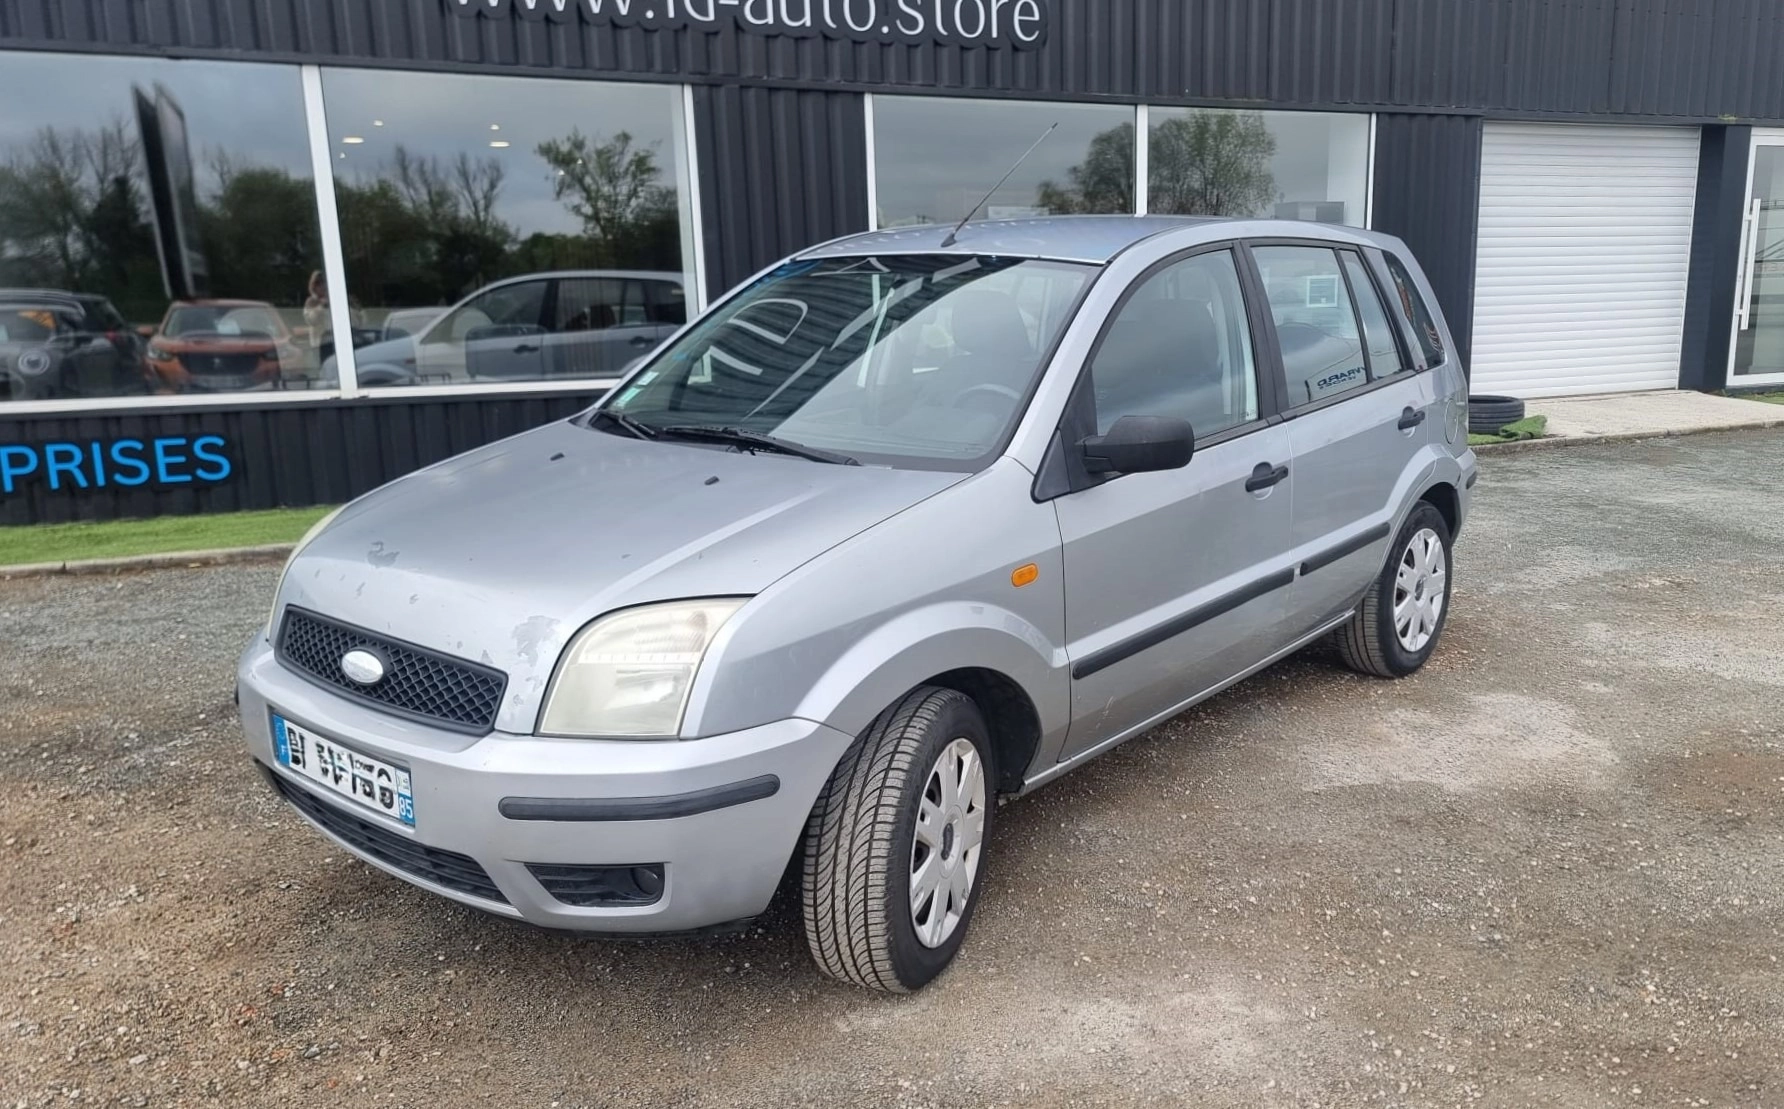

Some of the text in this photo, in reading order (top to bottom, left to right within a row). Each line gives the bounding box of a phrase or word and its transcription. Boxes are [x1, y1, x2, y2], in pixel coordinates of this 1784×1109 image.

[457, 0, 1040, 41] .-auto.store
[0, 436, 231, 493] PRISES
[399, 797, 414, 819] 85
